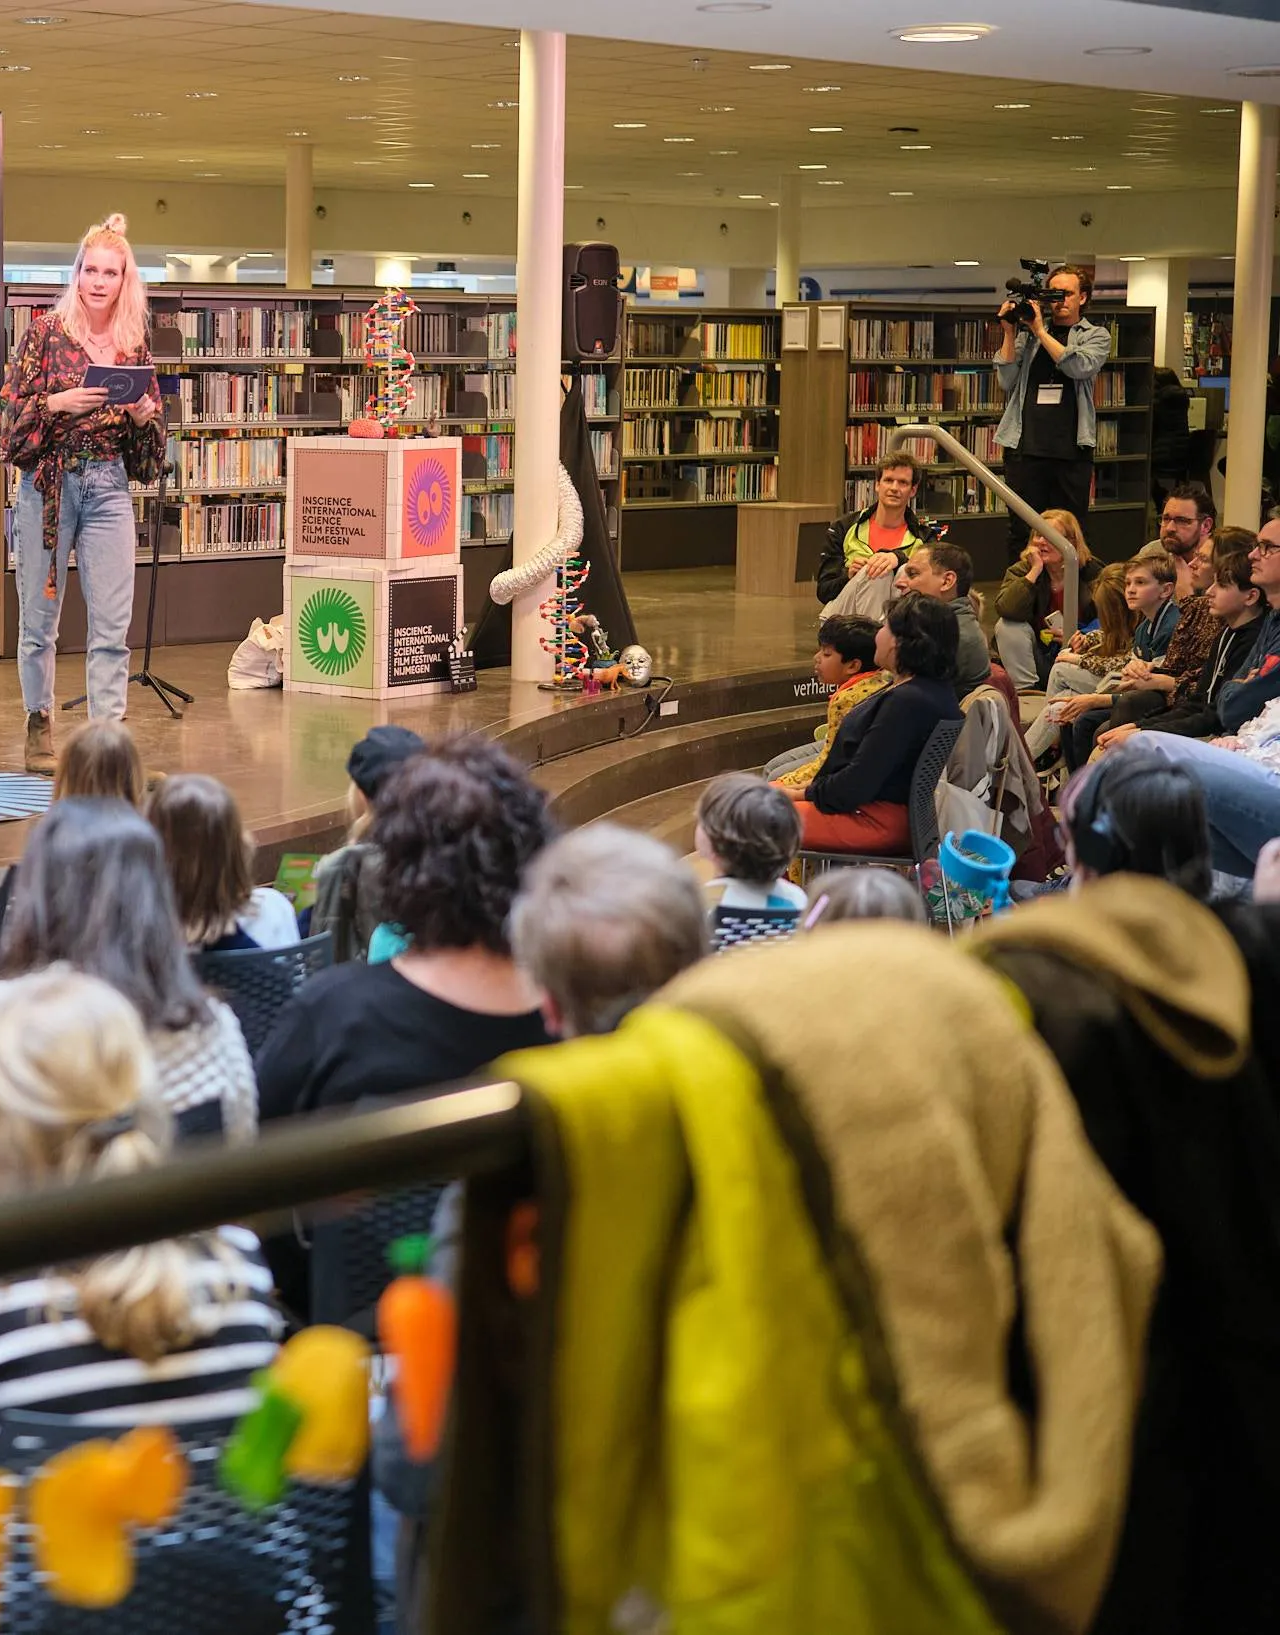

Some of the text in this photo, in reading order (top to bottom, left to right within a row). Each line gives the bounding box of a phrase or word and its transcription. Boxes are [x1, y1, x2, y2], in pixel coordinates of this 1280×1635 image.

[302, 496, 352, 507] INSCIENCE
[302, 506, 377, 518] INTERNATIONAL
[302, 515, 342, 526] SCIENCE
[302, 525, 366, 536] FILM FESTIVAL
[302, 535, 350, 545] NIJMEGEN
[394, 625, 433, 637] INSCIENCE
[394, 633, 450, 647] INTERNATIONAL
[393, 645, 425, 657] SCIENCE
[393, 653, 442, 667] FILM FESTIVAL
[393, 664, 430, 676] NIJMEGEN
[793, 678, 839, 697] verhale
